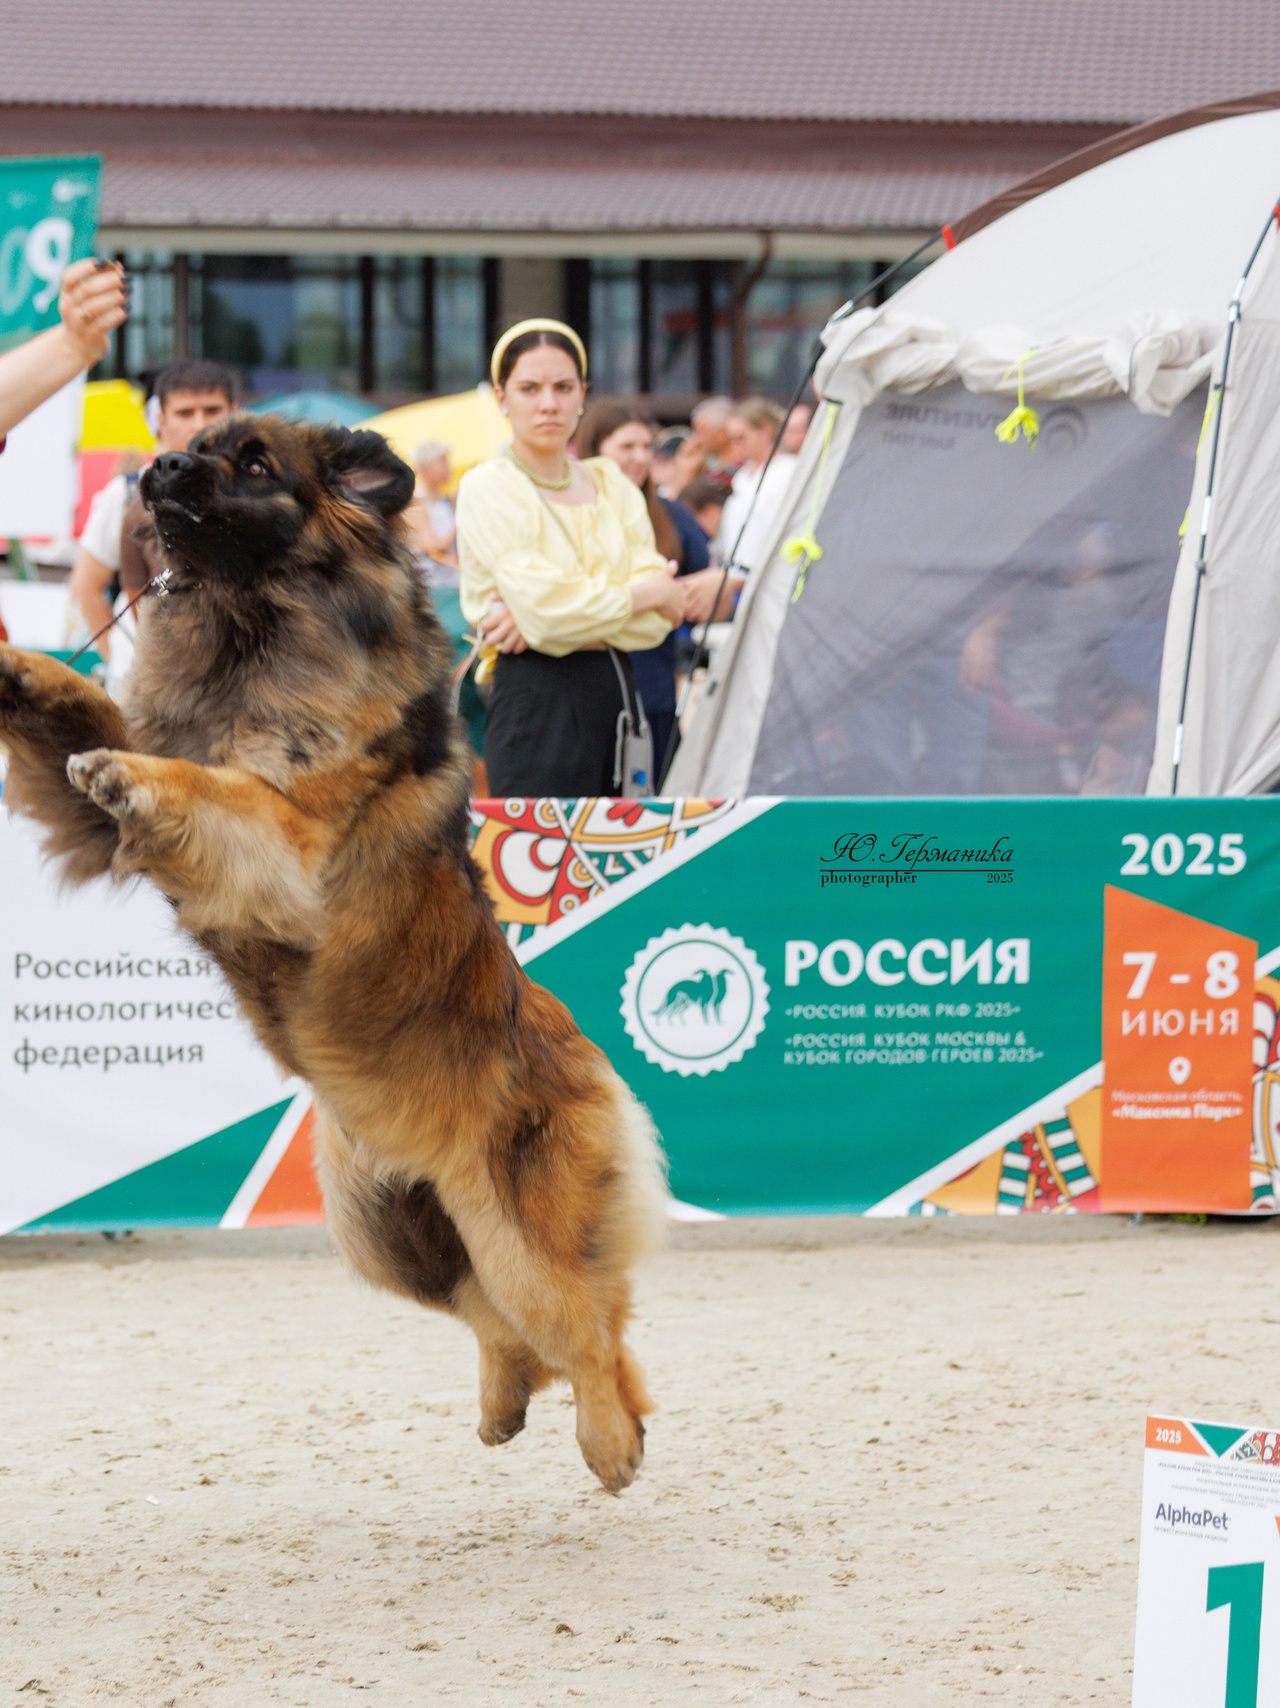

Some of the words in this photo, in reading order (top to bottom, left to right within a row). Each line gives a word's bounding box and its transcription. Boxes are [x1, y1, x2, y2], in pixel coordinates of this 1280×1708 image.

[1119, 832, 1247, 876] 2025
[14, 952, 211, 980] Российская
[784, 937, 1031, 987] РОССИЯ
[1122, 952, 1157, 999] 7
[1203, 950, 1240, 999] 8
[13, 999, 233, 1023] кинологичес
[874, 1003, 931, 1019] КУБОК
[934, 1002, 971, 1018] РКФ
[1121, 1008, 1239, 1036] ИЮНЯ
[874, 1032, 931, 1048] КУБОК
[934, 1031, 1011, 1047] МОСКВЫ
[1014, 1031, 1027, 1046] &
[13, 1038, 204, 1073] федерация
[784, 1049, 841, 1065] КУБОК
[1155, 1427, 1182, 1445] 2025
[1155, 1502, 1228, 1531] AlphaPet
[1205, 1560, 1265, 1708] 1
